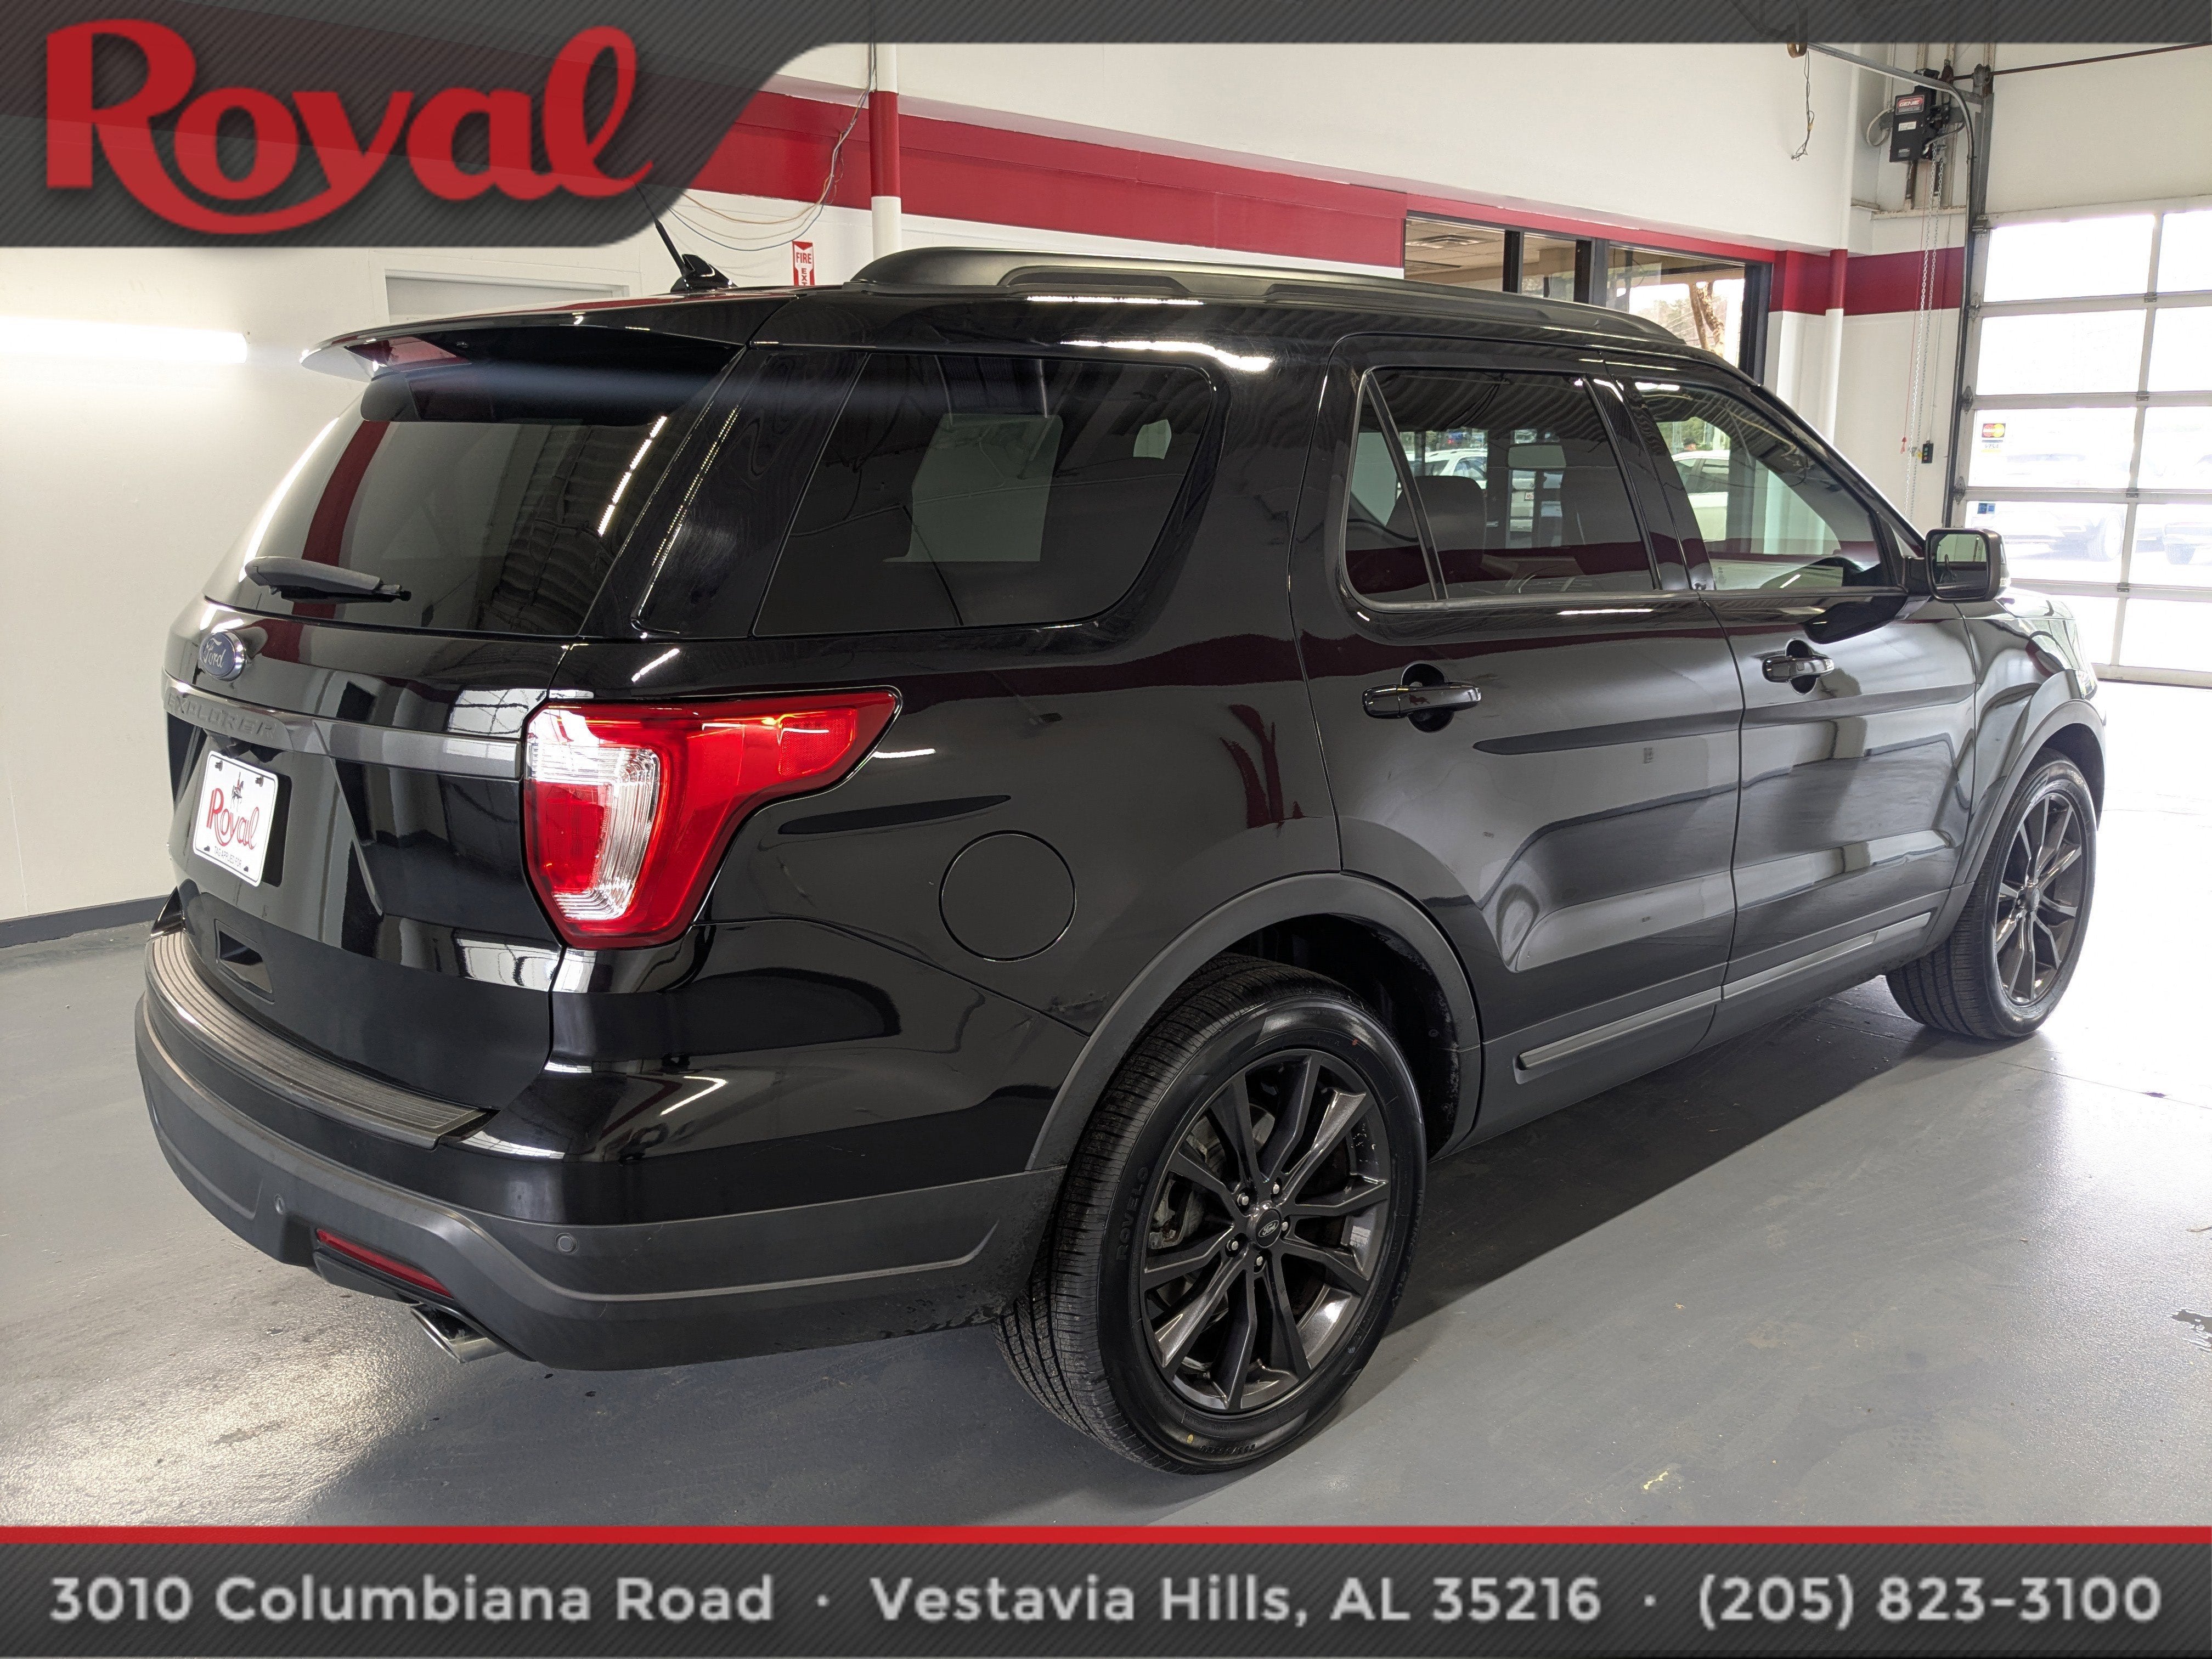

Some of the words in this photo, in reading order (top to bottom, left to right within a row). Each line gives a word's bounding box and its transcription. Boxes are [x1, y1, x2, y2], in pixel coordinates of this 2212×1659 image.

[795, 252, 812, 264] FIRE
[202, 637, 227, 668] Ford
[168, 692, 274, 738] EXPLORER
[206, 788, 259, 850] Royal
[1116, 1167, 1148, 1260] ROVELO
[1262, 1222, 1277, 1236] Ford
